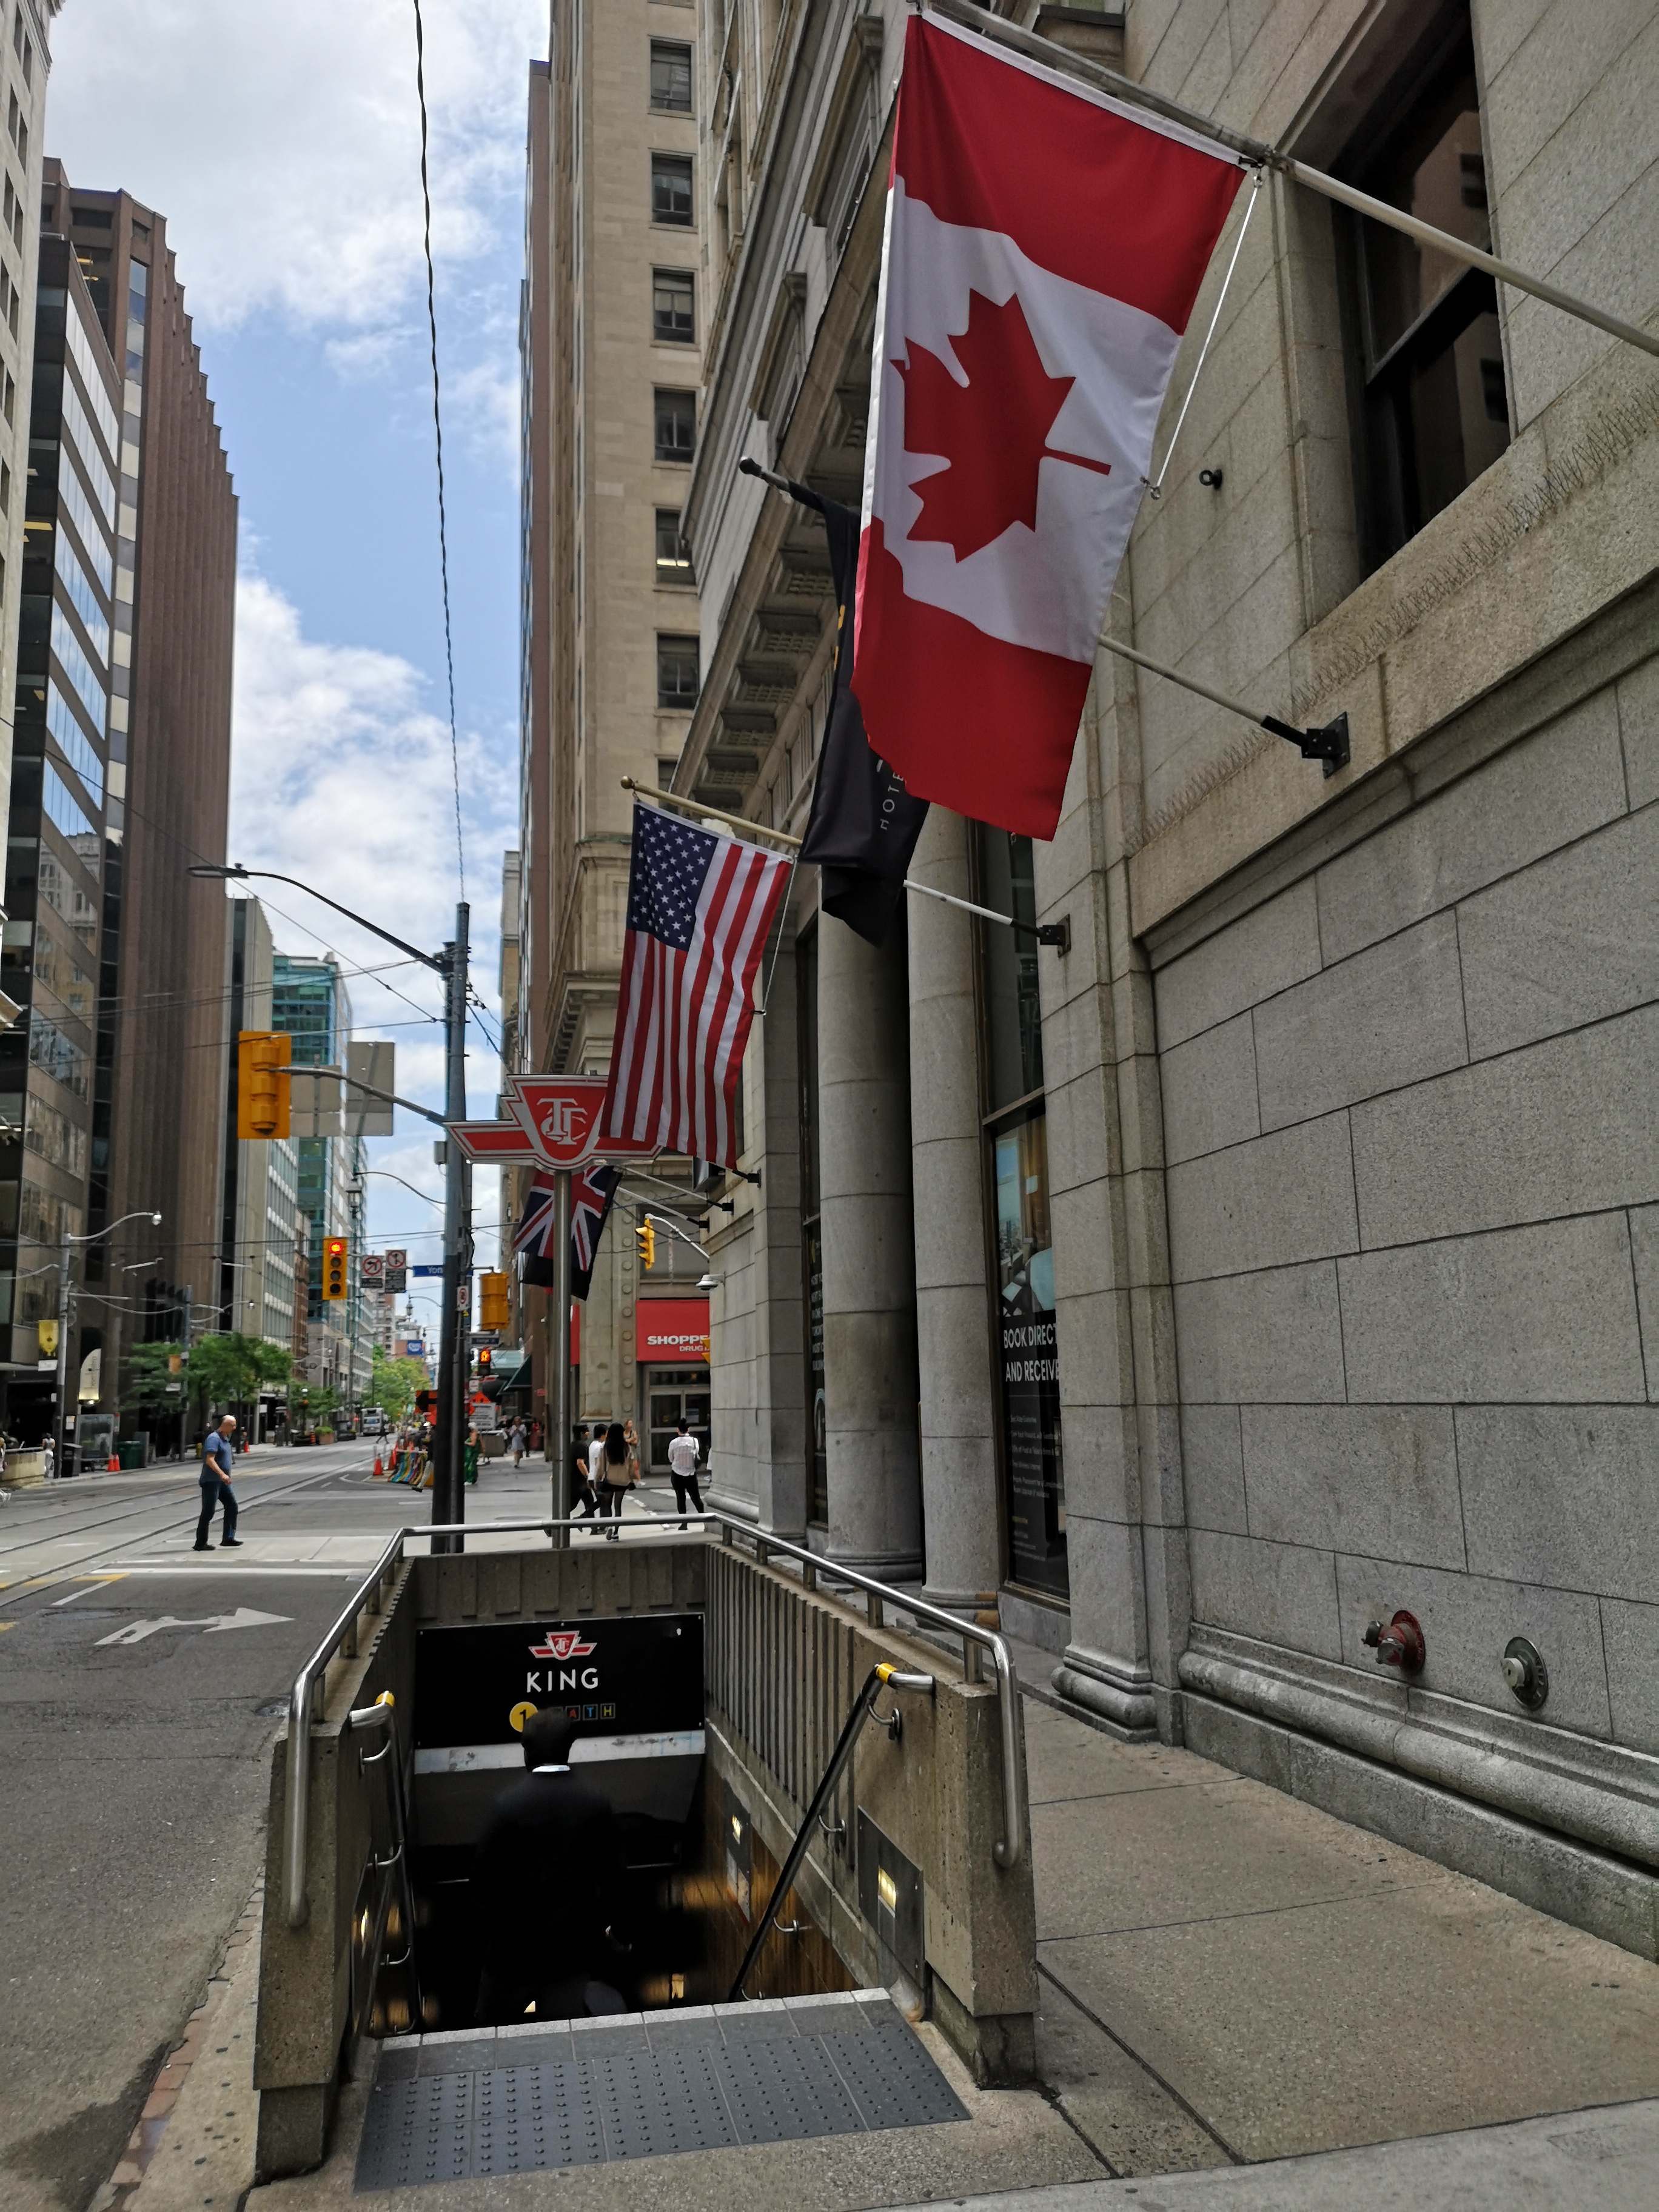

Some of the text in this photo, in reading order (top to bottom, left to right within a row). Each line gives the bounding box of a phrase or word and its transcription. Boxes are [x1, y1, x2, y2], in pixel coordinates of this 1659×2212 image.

[1004, 1323, 1056, 1349] BOOK DIREC
[1006, 1361, 1022, 1382] AND
[526, 1667, 598, 1693] KING
